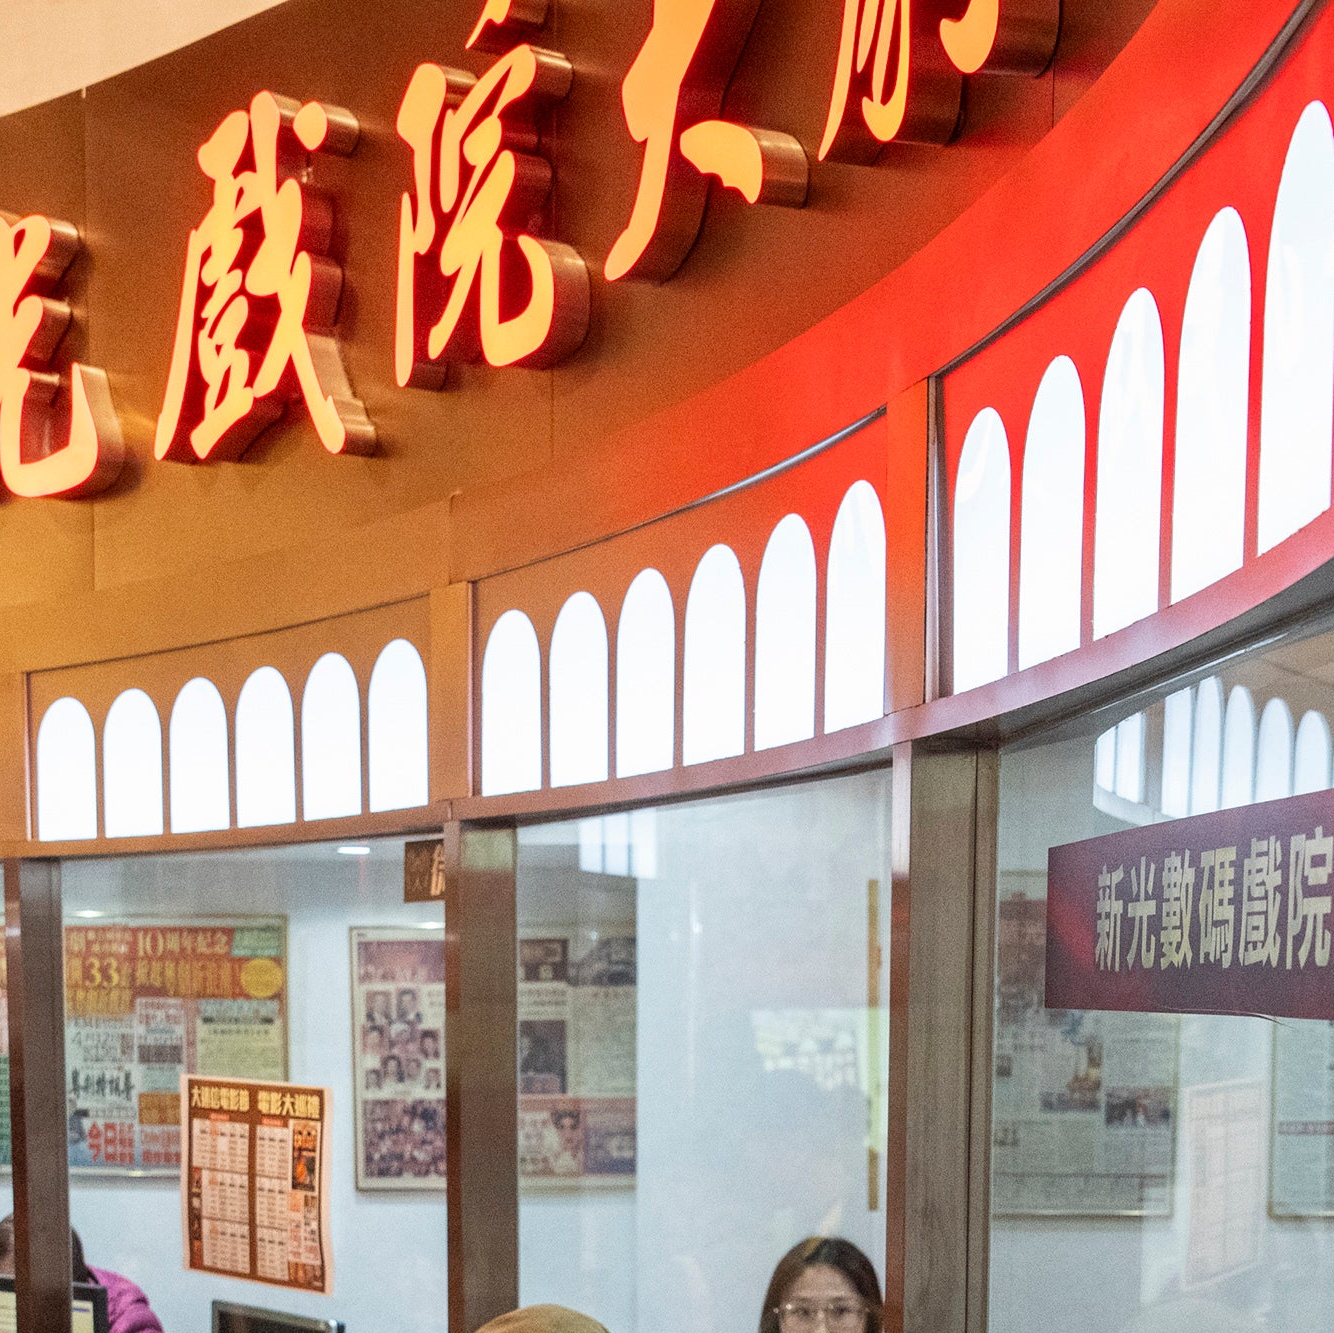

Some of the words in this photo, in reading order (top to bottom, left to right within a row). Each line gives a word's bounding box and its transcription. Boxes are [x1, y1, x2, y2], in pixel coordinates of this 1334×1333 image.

[1094, 826, 1334, 971] 新光數碼戲院
